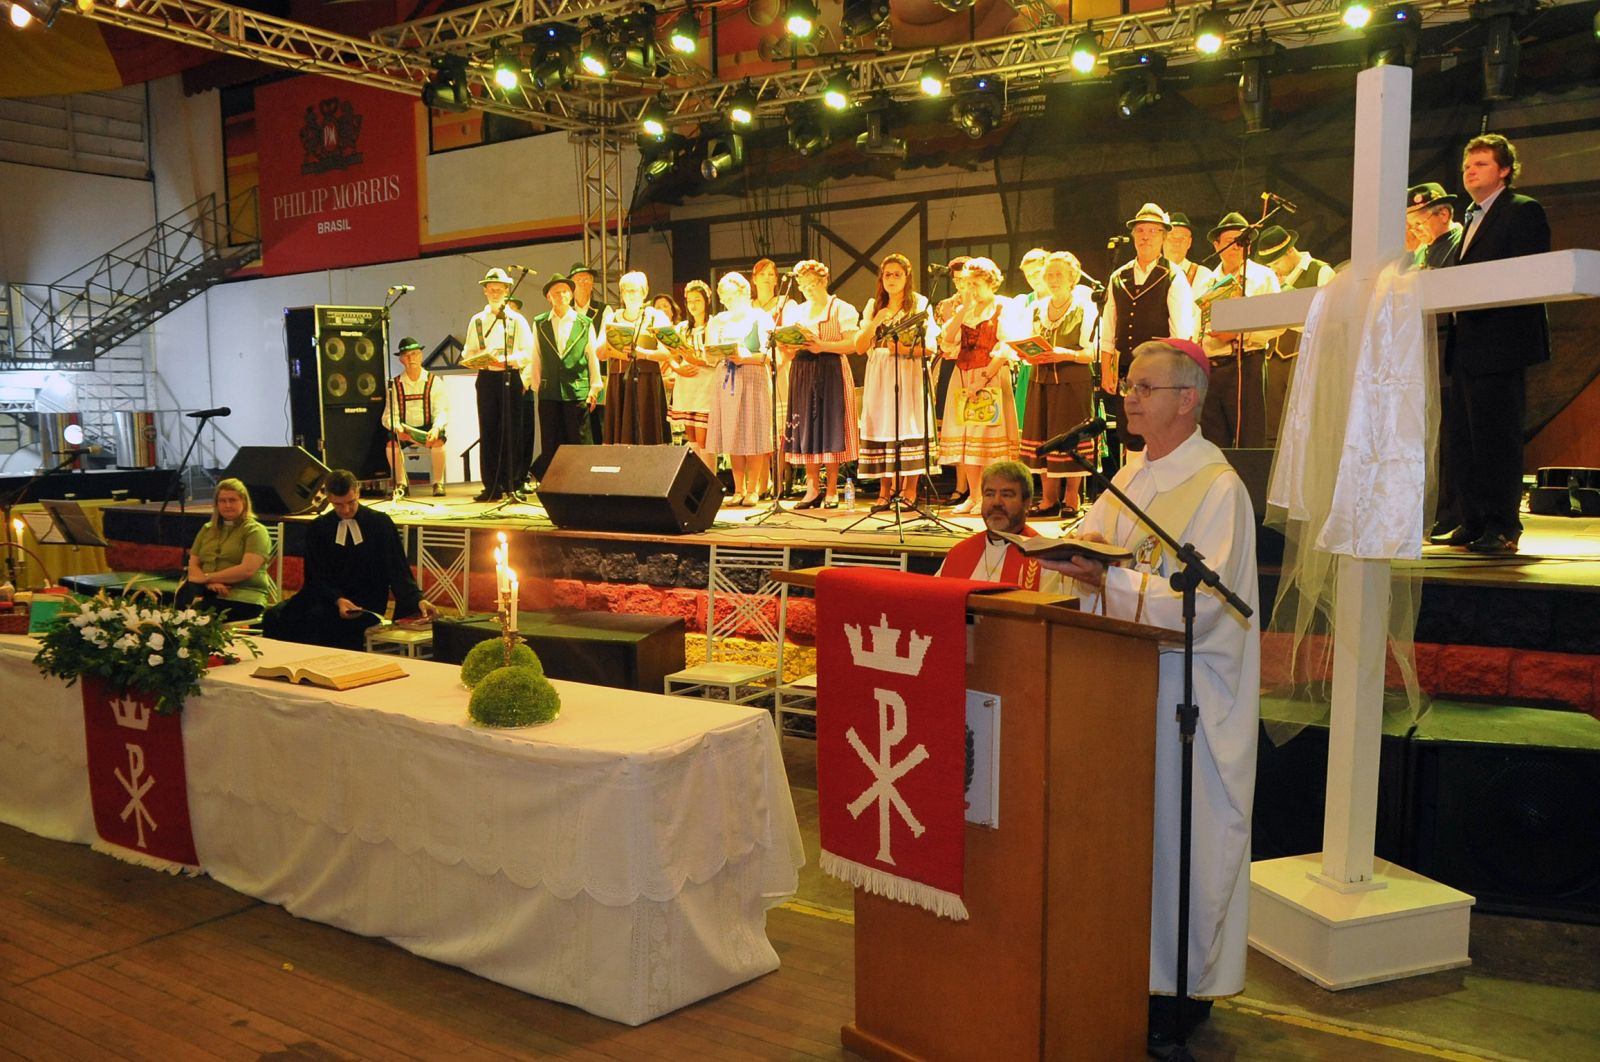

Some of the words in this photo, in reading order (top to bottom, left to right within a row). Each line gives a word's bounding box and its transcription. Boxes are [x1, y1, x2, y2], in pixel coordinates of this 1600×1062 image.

[272, 187, 328, 221] PHILIP
[332, 174, 401, 211] MORRIS
[317, 218, 352, 235] BRASIL
